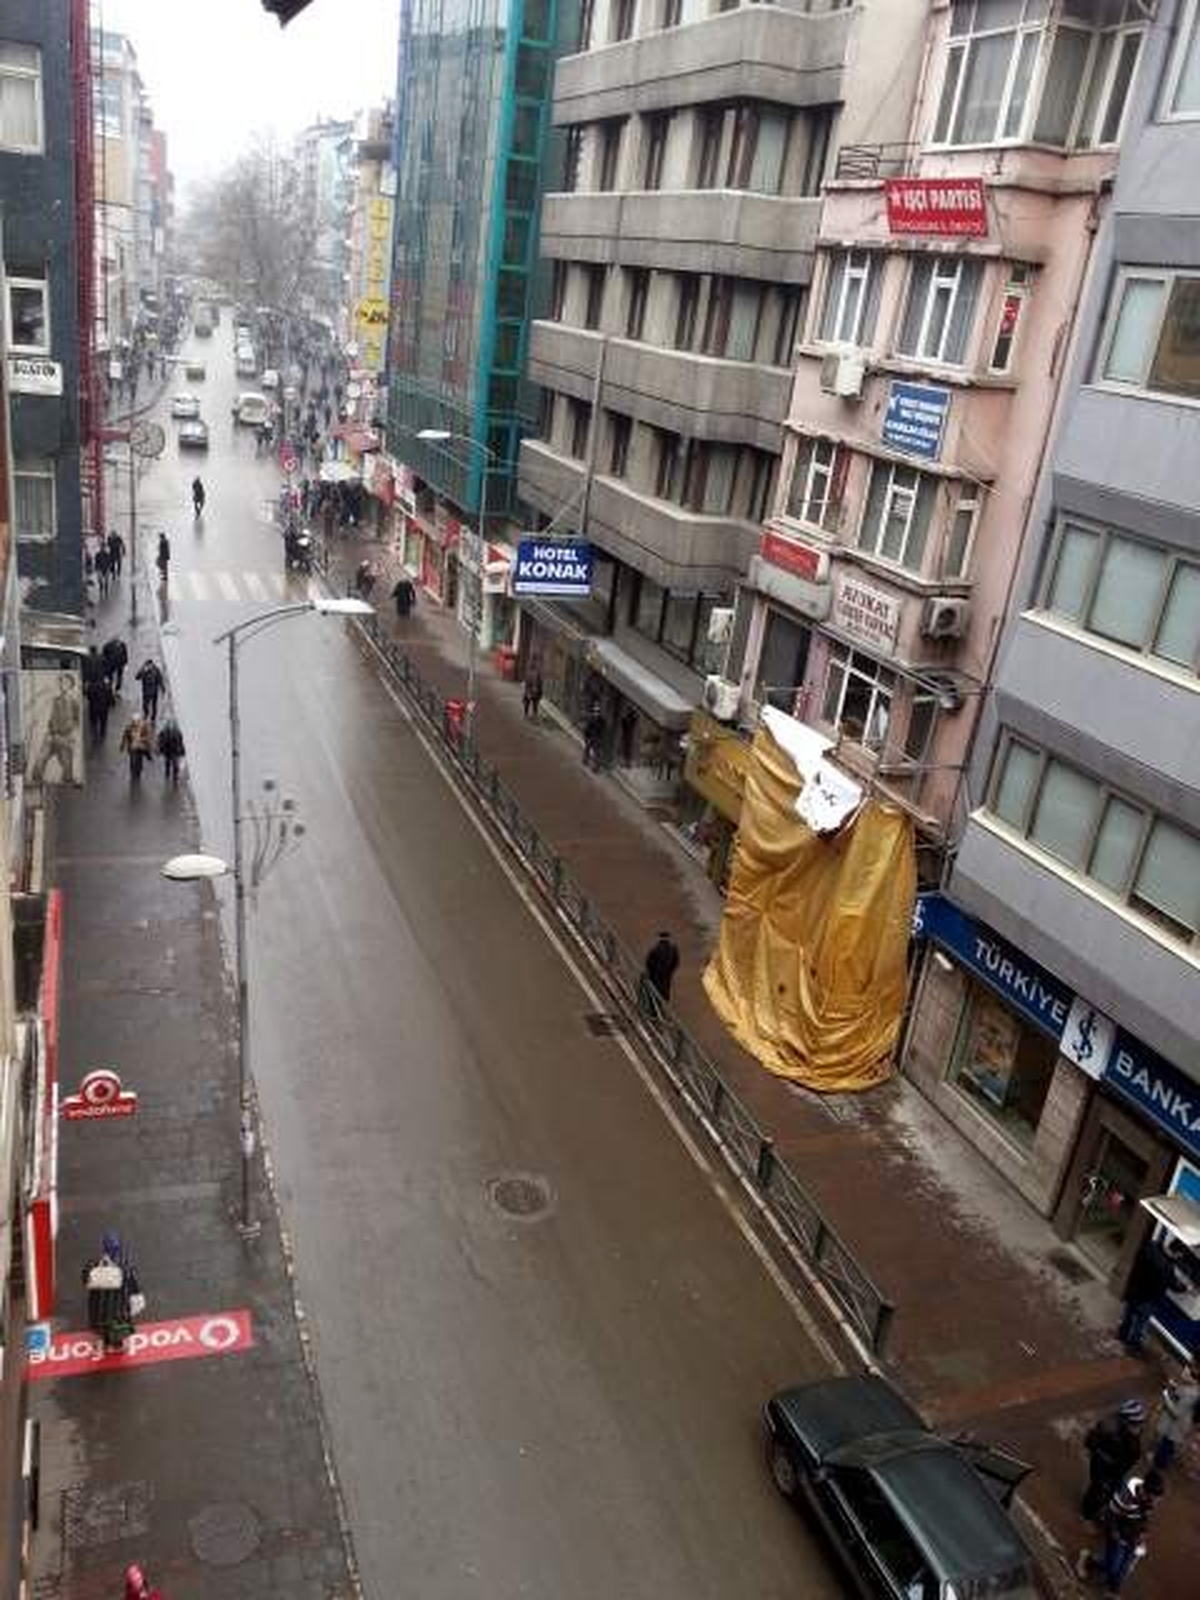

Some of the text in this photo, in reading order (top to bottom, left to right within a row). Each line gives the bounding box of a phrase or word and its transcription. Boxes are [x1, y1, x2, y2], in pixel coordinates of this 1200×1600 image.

[929, 182, 982, 211] PARTİSİ
[533, 546, 579, 561] HOTEL
[520, 561, 588, 580] KONAK
[974, 938, 1067, 1024] TÜRKİYE
[29, 1327, 192, 1364] vodfone
